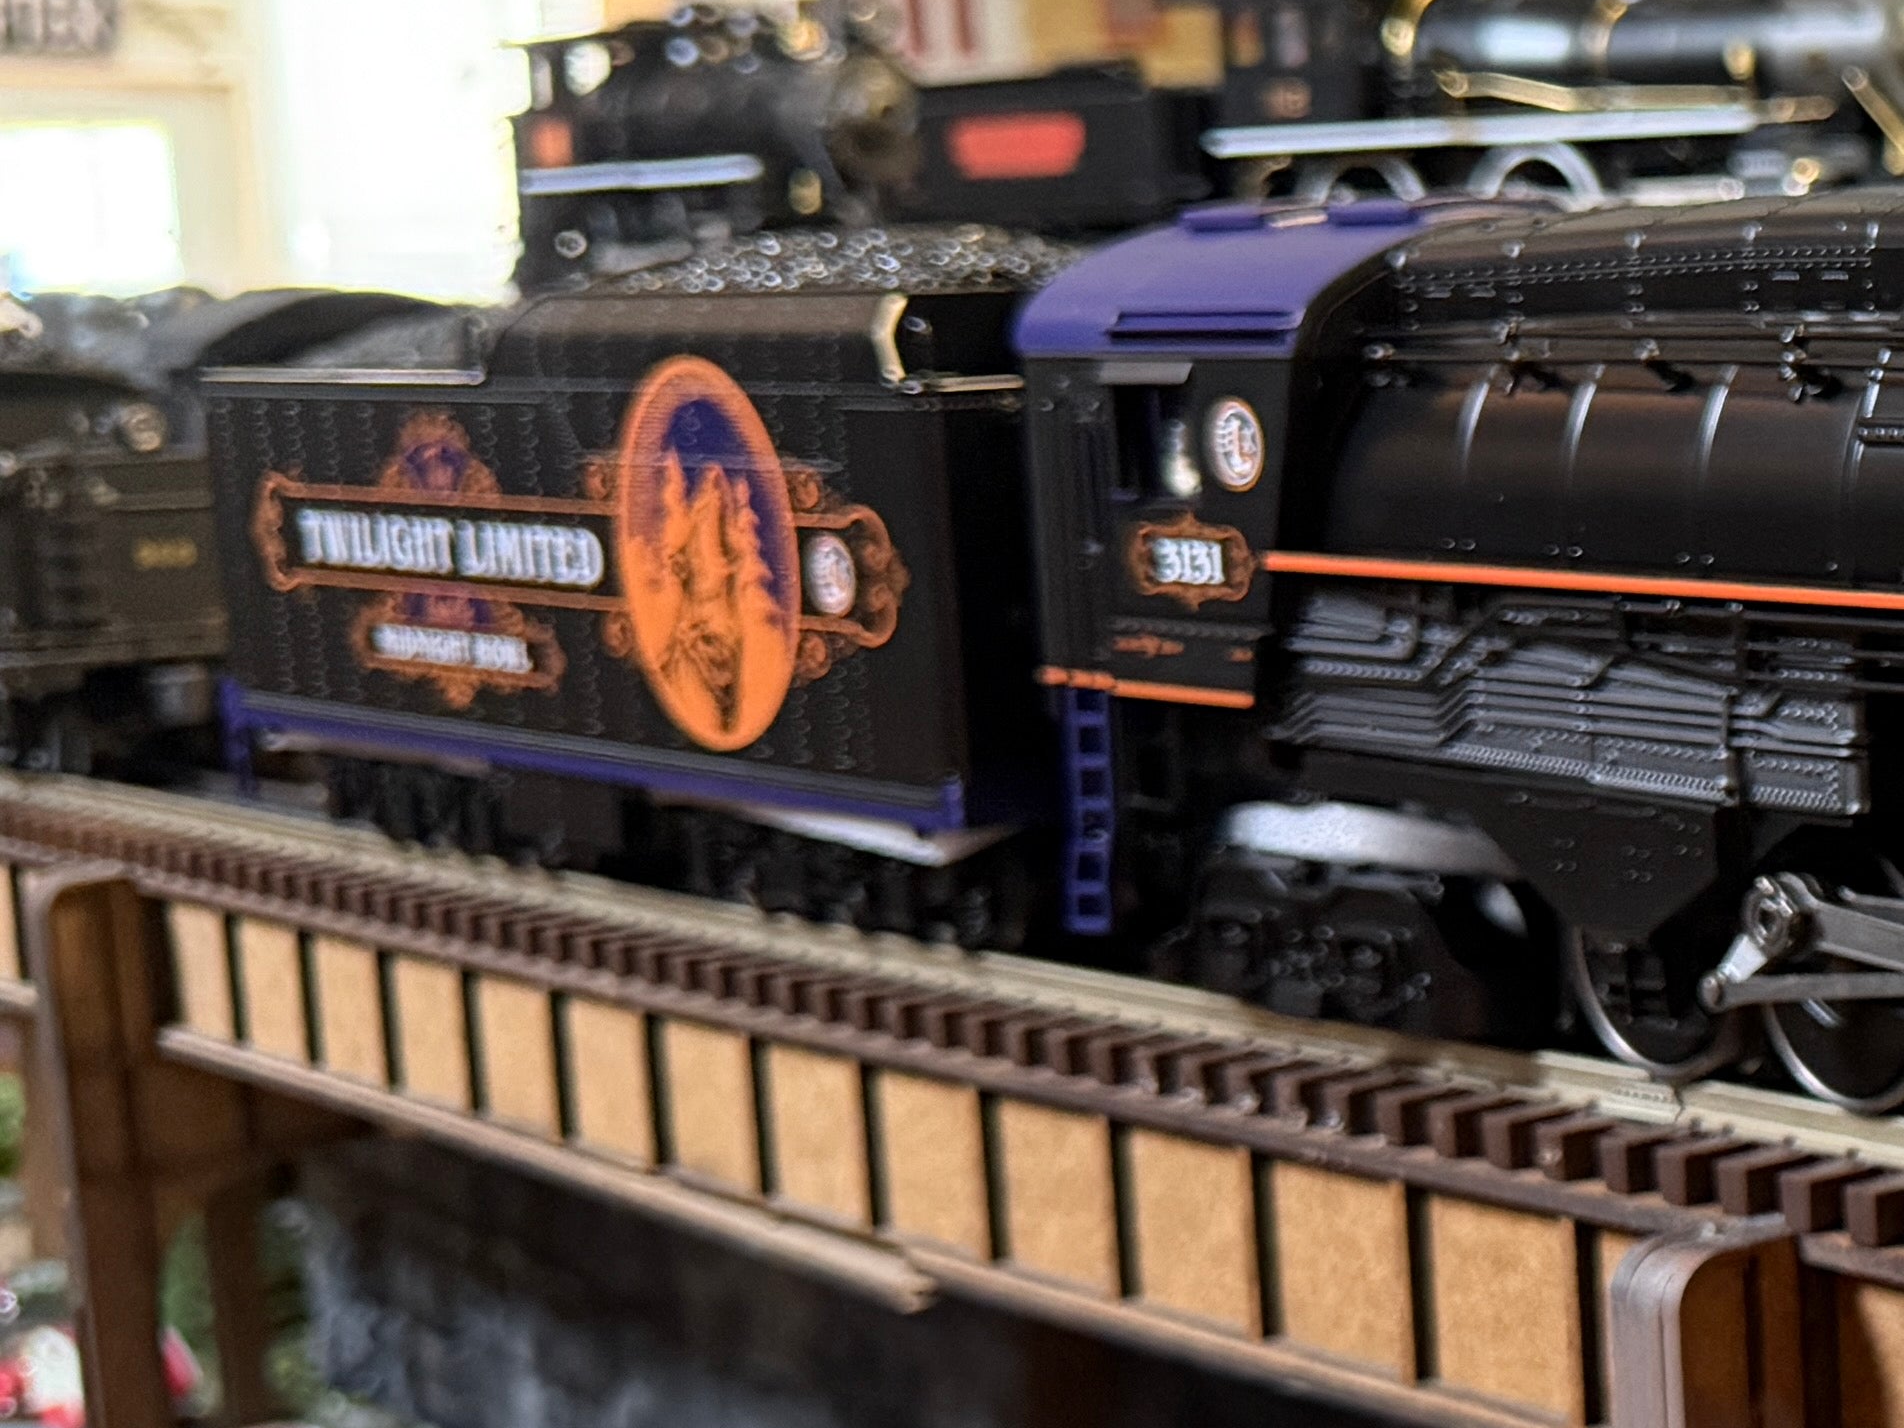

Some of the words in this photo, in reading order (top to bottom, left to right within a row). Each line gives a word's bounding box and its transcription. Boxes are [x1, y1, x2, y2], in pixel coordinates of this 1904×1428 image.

[298, 508, 454, 575] TWILIGHT
[454, 518, 605, 588] LIMITED
[1153, 537, 1225, 586] 3131
